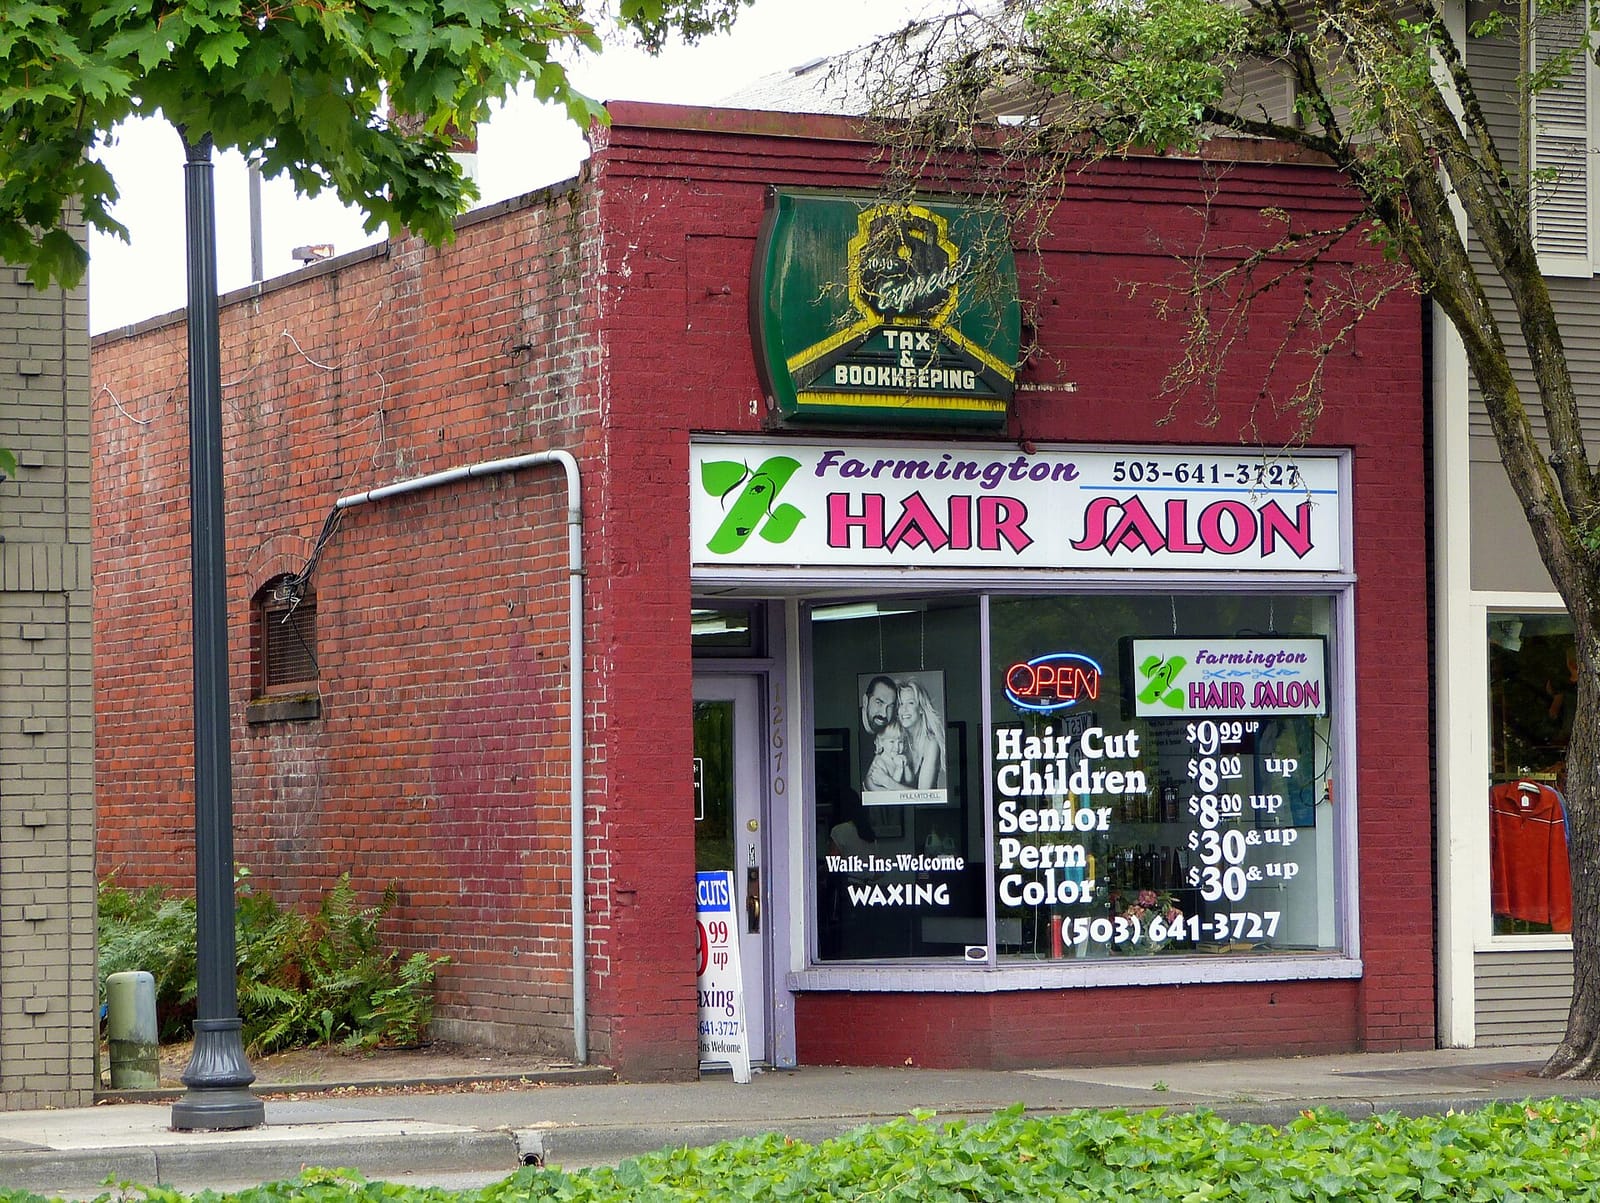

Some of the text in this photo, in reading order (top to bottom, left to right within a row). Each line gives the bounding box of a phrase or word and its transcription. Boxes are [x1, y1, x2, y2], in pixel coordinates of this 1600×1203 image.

[883, 330, 930, 351] TAX
[900, 350, 915, 367] &
[835, 364, 975, 389] BOOKKEEPING
[814, 450, 1080, 490] Farmington
[1113, 461, 1298, 486] 503-641-3727
[826, 490, 1314, 560] HAIR SALON
[1195, 649, 1308, 669] Farmington
[1006, 663, 1098, 700] OPEN
[1188, 680, 1321, 710] HAIR SALON
[996, 726, 1071, 760] Hair
[1080, 727, 1140, 759] Cut
[1245, 721, 1259, 733] UP
[996, 759, 1147, 796] Children
[1264, 758, 1299, 778] up
[998, 800, 1112, 834] Senior
[1249, 794, 1283, 814] up
[825, 854, 964, 873] Walk-Ins-Welcome
[999, 837, 1087, 870] Perm
[1188, 829, 1247, 866] $30
[847, 883, 950, 907] WAXING
[999, 868, 1095, 906] Color
[1188, 866, 1247, 902] $30
[1061, 911, 1281, 946] (503) 641-3727
[713, 952, 728, 970] up
[711, 1040, 741, 1053] Welcome
